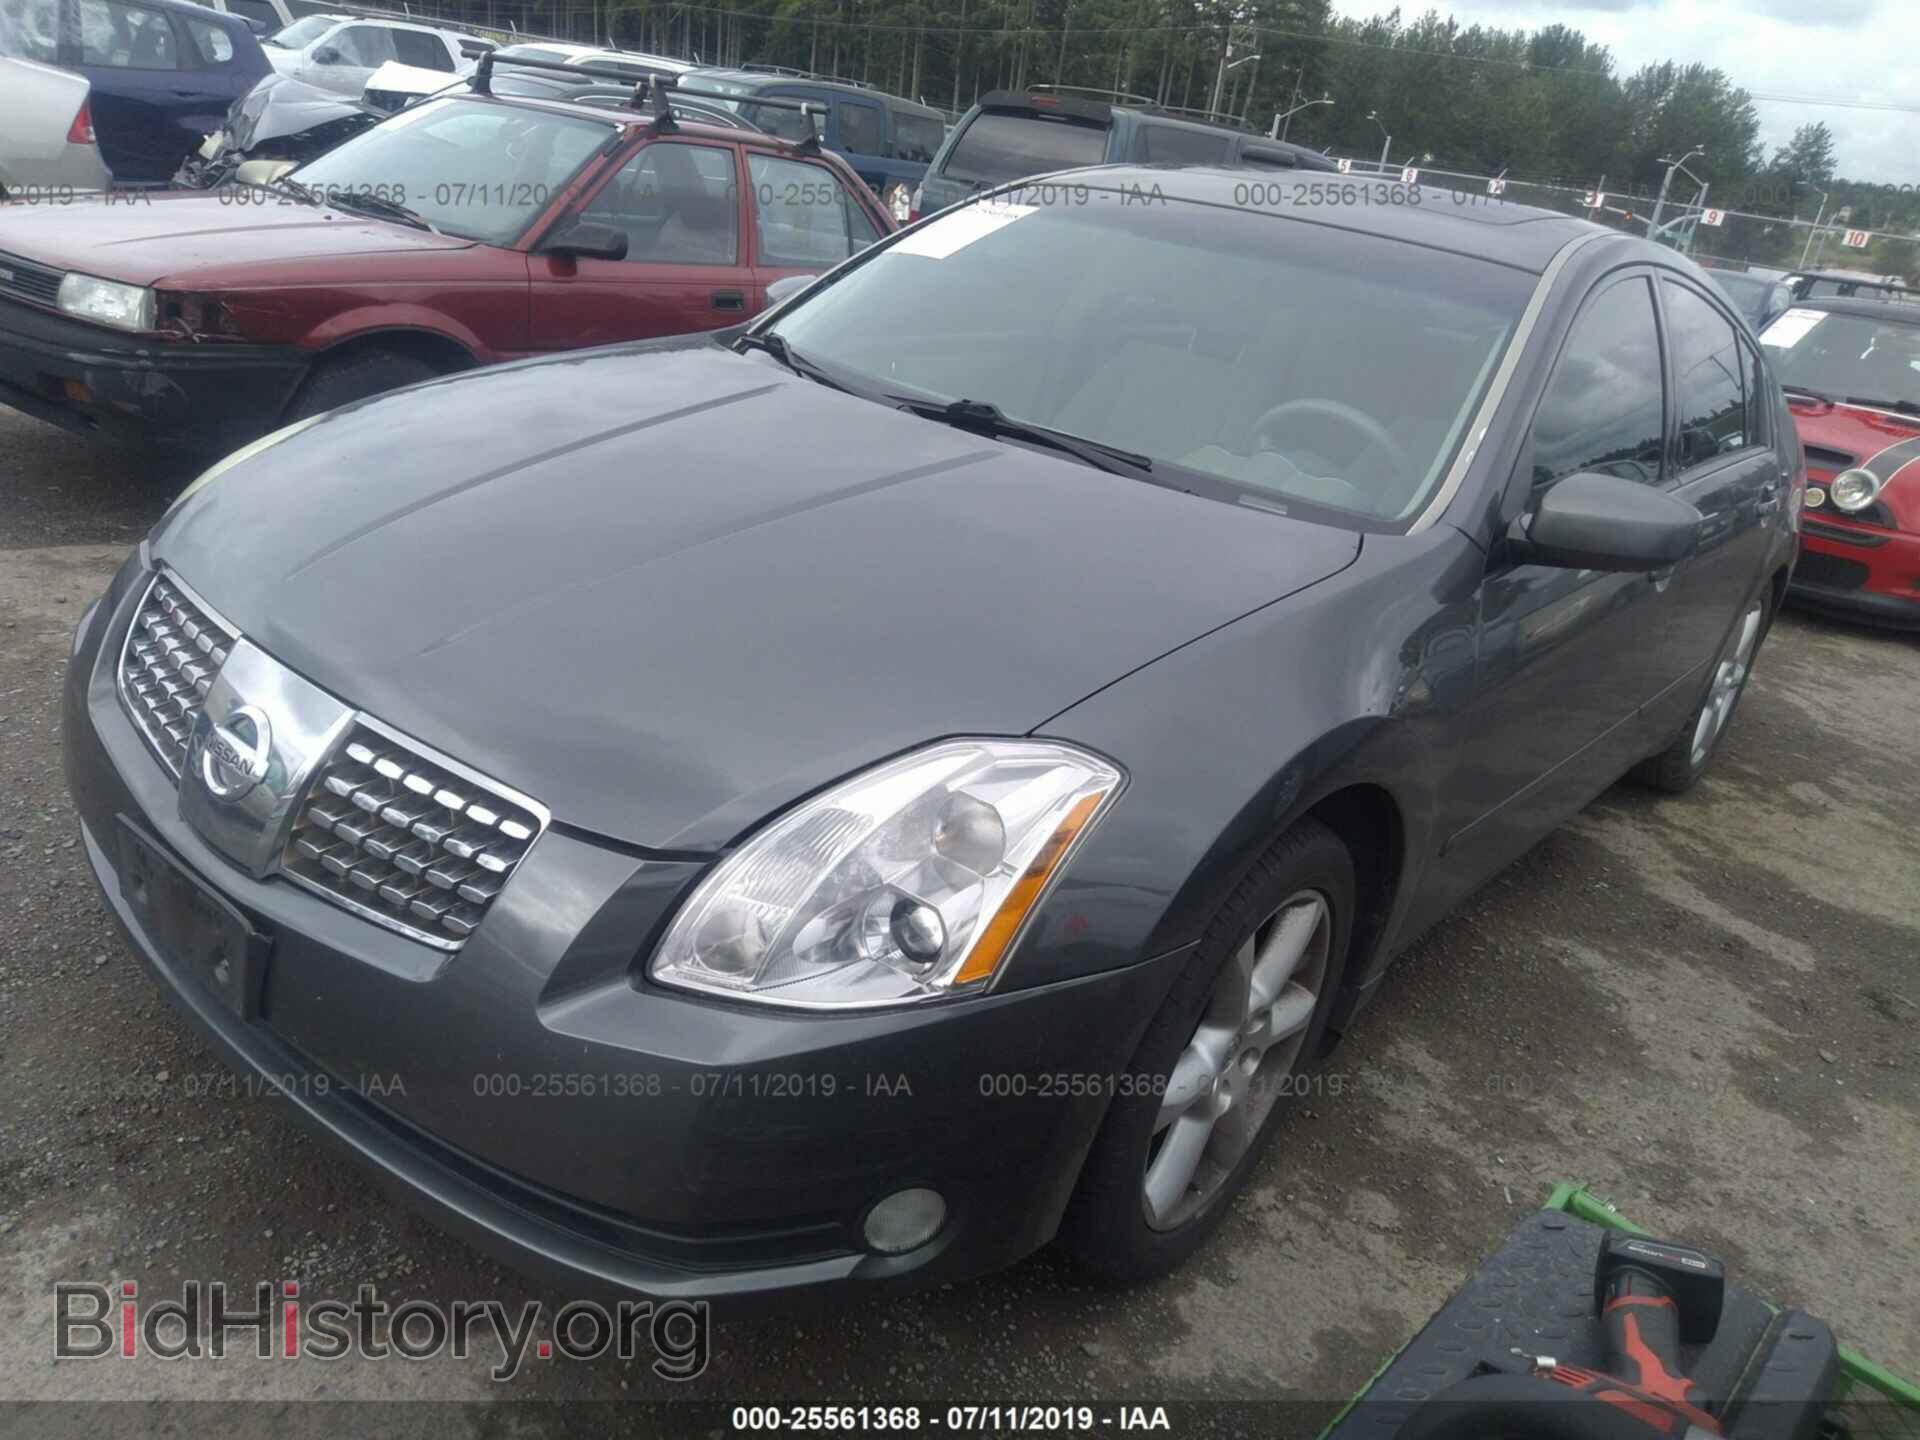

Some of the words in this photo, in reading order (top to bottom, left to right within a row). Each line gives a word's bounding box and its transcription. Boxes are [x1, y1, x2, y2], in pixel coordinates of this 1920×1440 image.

[1707, 211, 1718, 225] 9
[1848, 231, 1865, 246] 10
[206, 735, 255, 776] NISSAN
